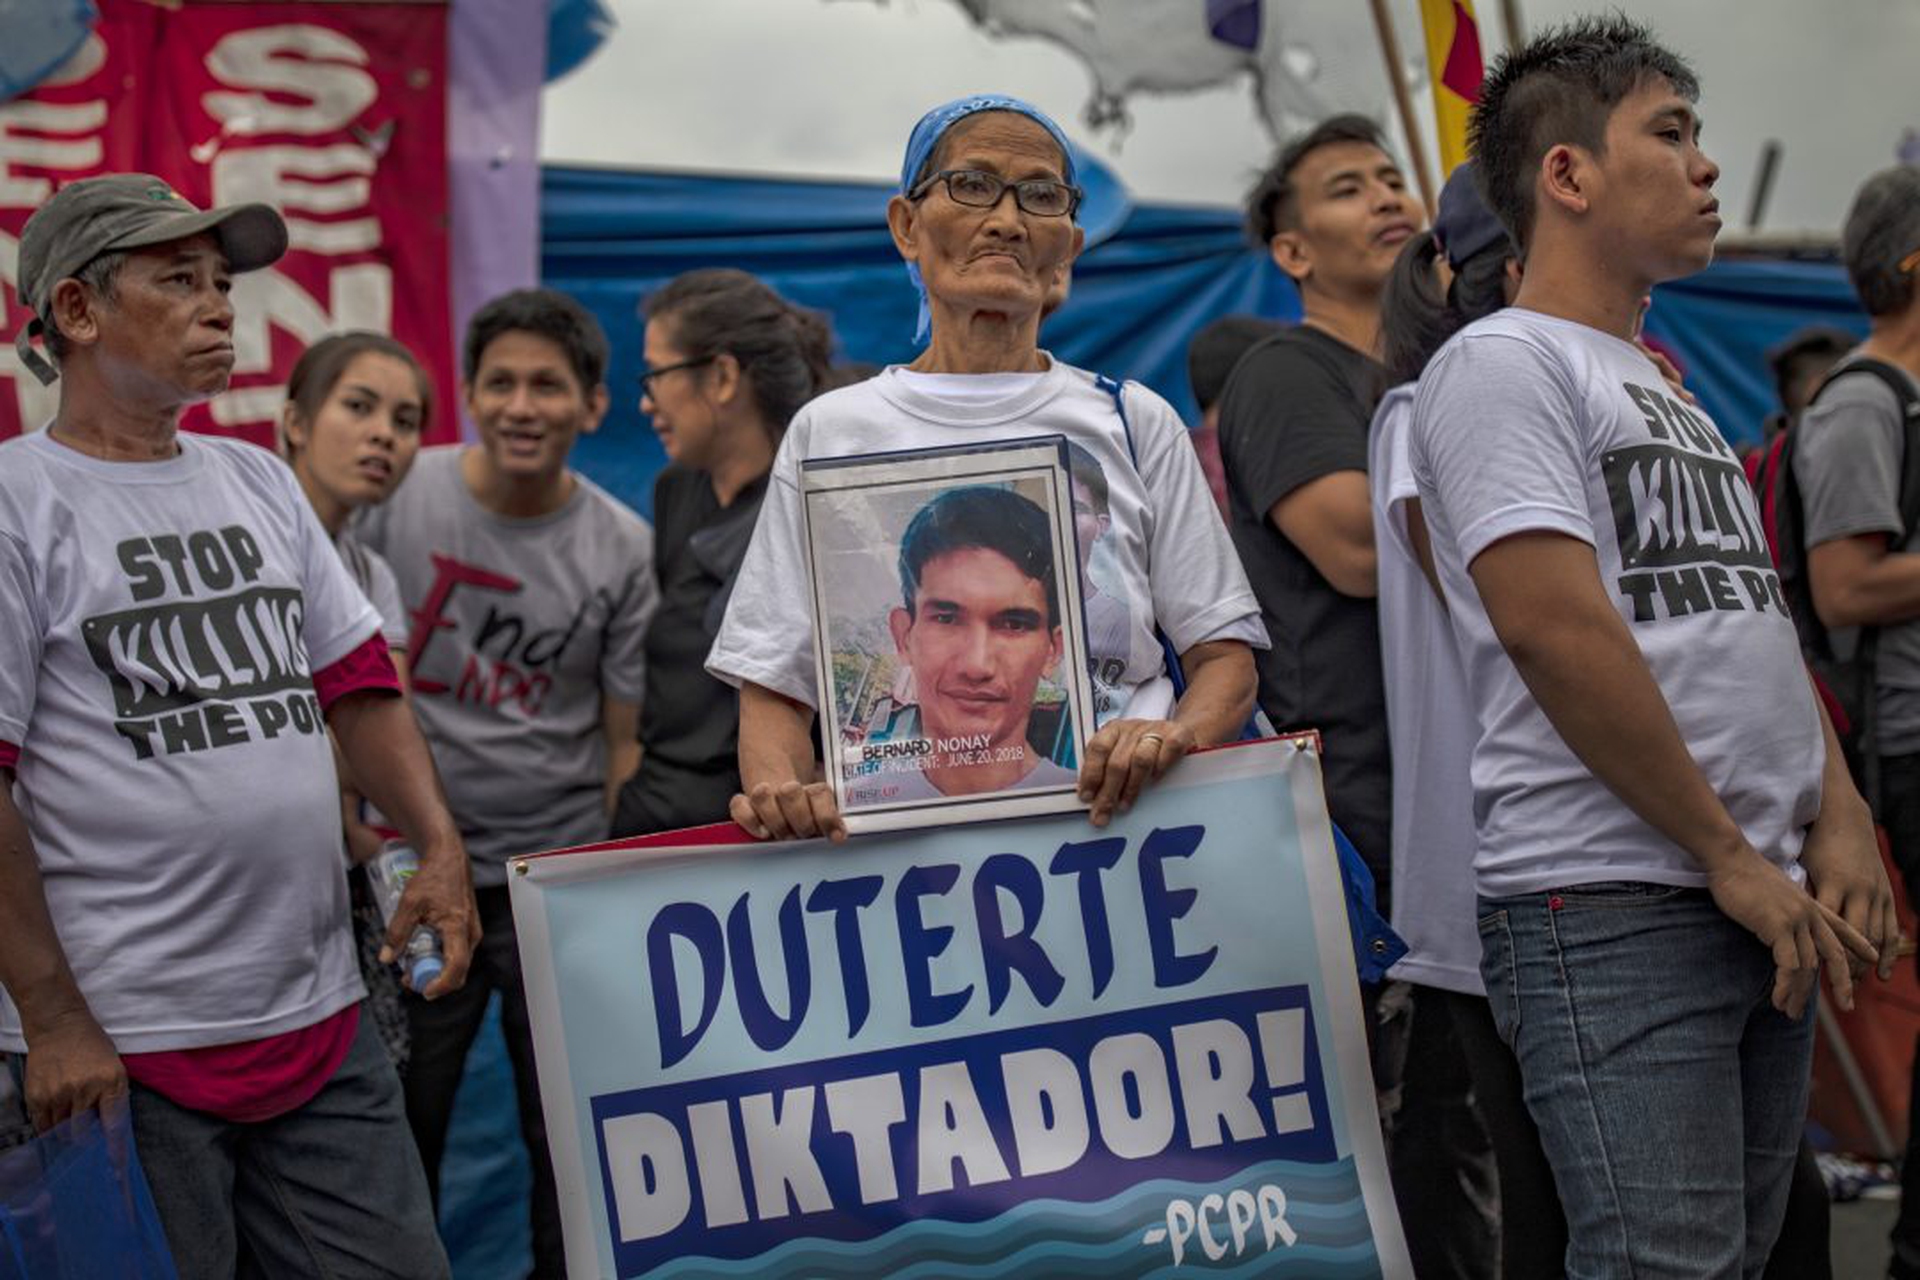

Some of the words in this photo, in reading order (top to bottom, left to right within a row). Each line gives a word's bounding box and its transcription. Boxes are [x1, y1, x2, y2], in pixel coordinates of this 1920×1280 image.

[1623, 382, 1729, 457] STOP
[116, 525, 263, 602] STOP
[1618, 566, 1745, 622] THE
[108, 597, 311, 703] KILLING
[114, 704, 251, 760] THE
[862, 740, 932, 762] BERNARD
[938, 734, 992, 753] NONAY
[947, 751, 975, 767] JUNE
[996, 746, 1025, 762] 2018
[646, 825, 1219, 1069] DUTERTE
[602, 1008, 1314, 1244] DIKTADOR!
[1143, 1185, 1298, 1267] -PCPR
